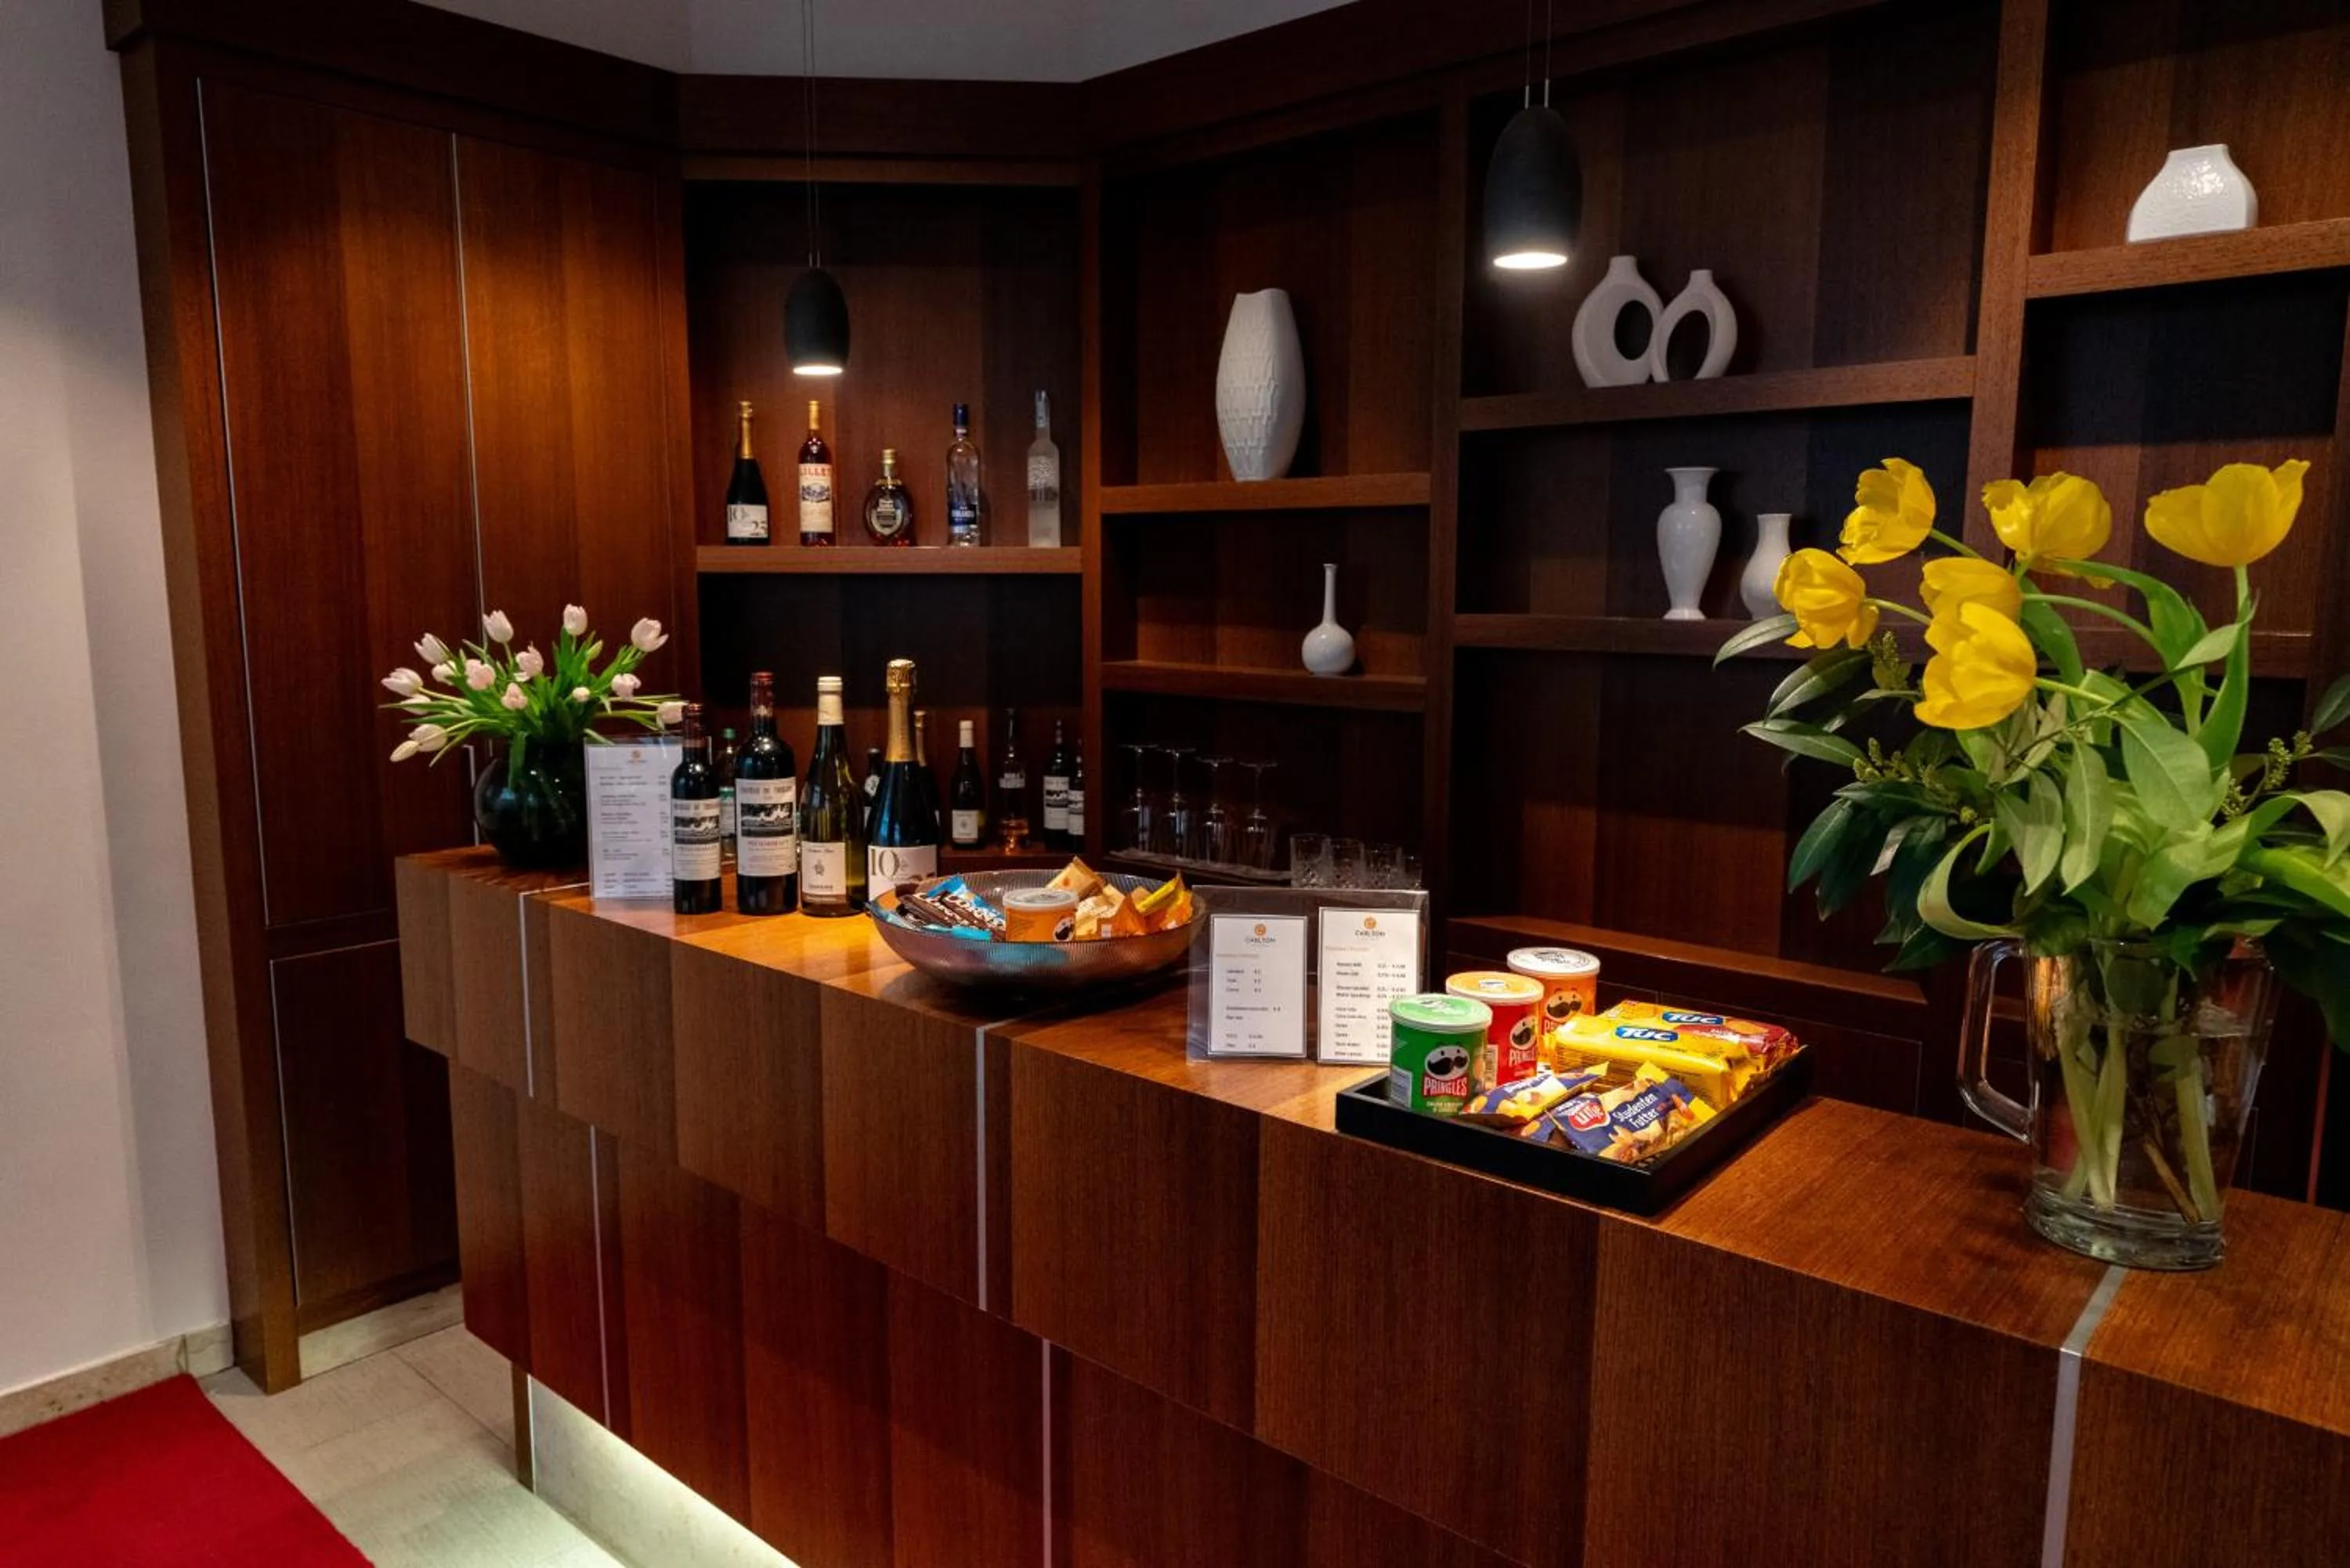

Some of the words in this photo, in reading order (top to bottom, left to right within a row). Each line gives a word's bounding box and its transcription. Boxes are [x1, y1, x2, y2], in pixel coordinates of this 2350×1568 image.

[1668, 1013, 1718, 1024] TUC
[1622, 1028, 1672, 1041] TUC
[1423, 1077, 1467, 1097] PRINGLES
[1612, 1093, 1658, 1122] Studenten
[1629, 1107, 1659, 1129] Futter
